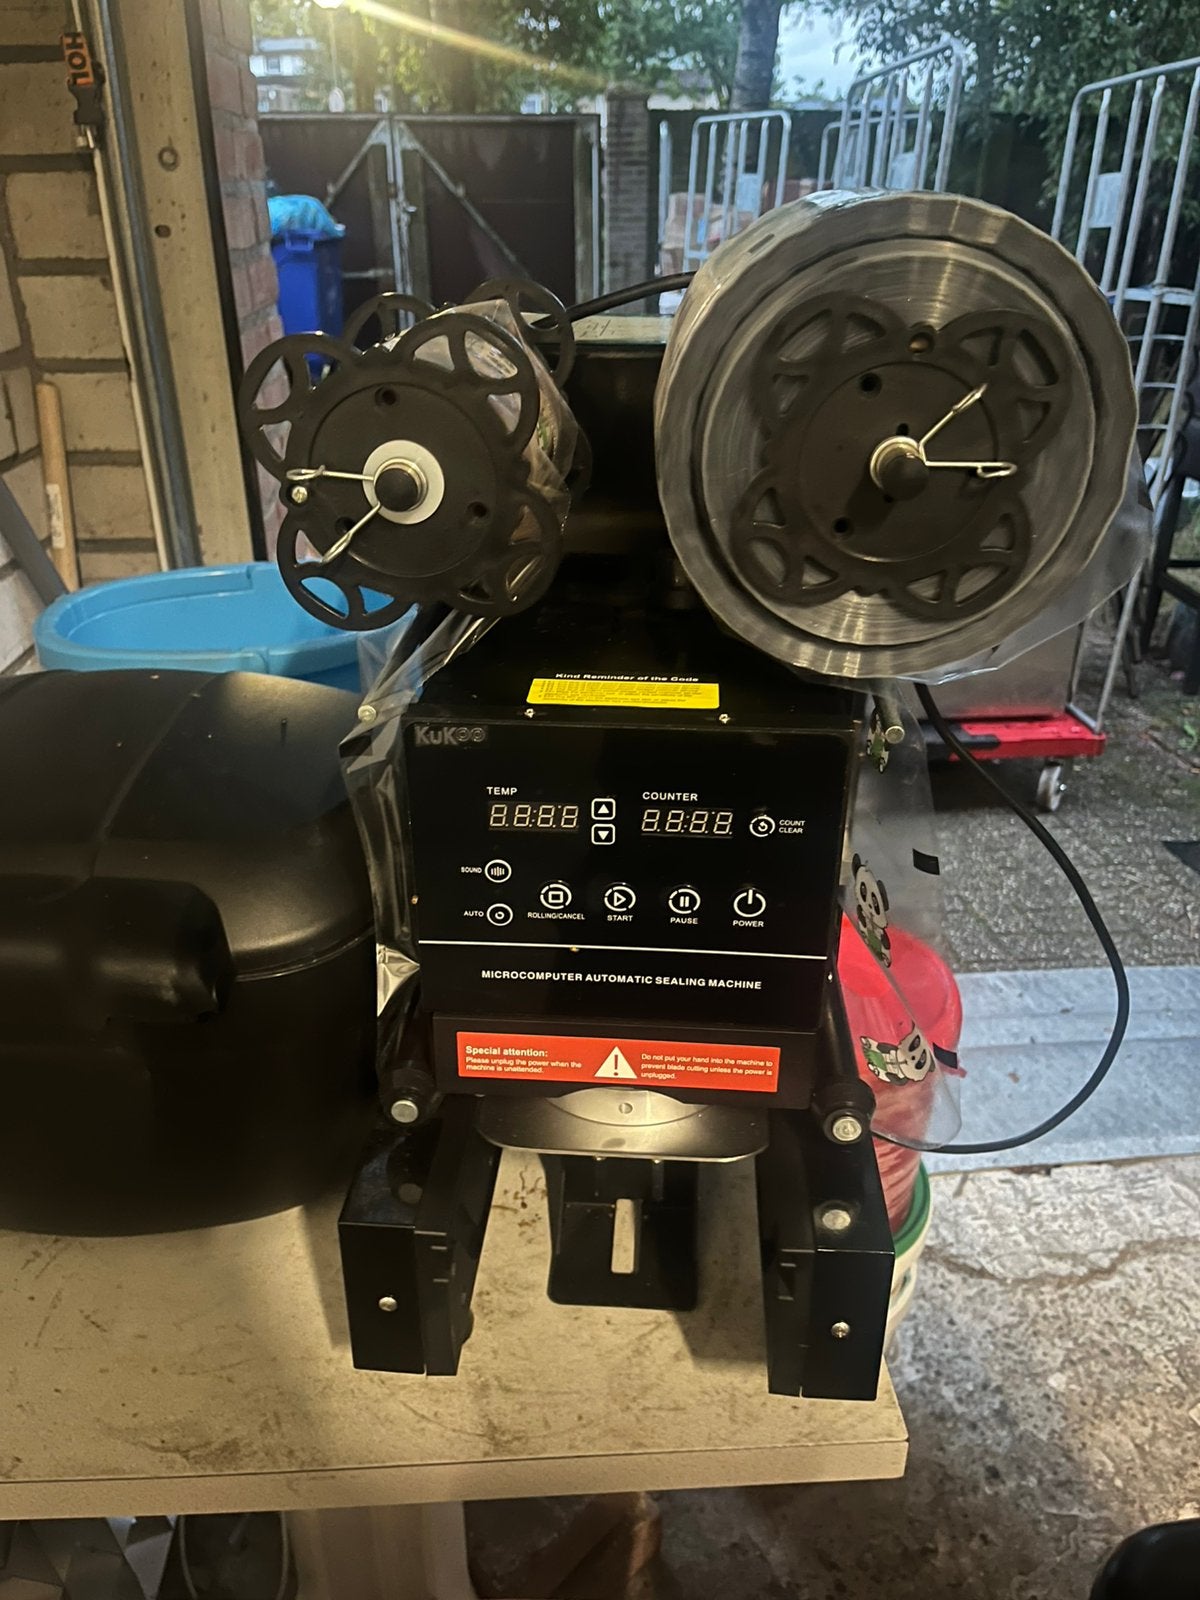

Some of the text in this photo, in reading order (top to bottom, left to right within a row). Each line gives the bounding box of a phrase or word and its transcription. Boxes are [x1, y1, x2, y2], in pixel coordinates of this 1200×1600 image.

[486, 786, 518, 796] TEMP
[642, 791, 698, 802] COUNTER
[779, 819, 806, 827] COUNT
[778, 827, 804, 835] CLEAR
[460, 866, 483, 874] SOUND
[463, 910, 484, 918] AUTO
[527, 911, 586, 921] ROLLING/CANCEL
[606, 914, 634, 923] START
[669, 916, 699, 926] PAUSE
[732, 919, 765, 928] POWER
[481, 970, 762, 990] MICROCOMPUTER AUTOMATIC SEALING MACHINE
[465, 1045, 549, 1058] Special attention:
[465, 1057, 490, 1065] Please
[491, 1059, 515, 1067] unplug
[515, 1059, 527, 1067] the
[641, 1053, 652, 1061] Do
[664, 1055, 676, 1063] put
[676, 1056, 692, 1064] your
[692, 1056, 710, 1064] hand
[711, 1057, 724, 1065] into
[724, 1057, 736, 1065] the
[737, 1058, 765, 1067] machine
[766, 1060, 774, 1068] to
[465, 1064, 496, 1072] machine
[504, 1066, 545, 1074] unattended.
[641, 1062, 667, 1071] prevent
[667, 1064, 686, 1072] blade
[687, 1065, 709, 1074] cutting
[710, 1066, 731, 1074] unless
[733, 1067, 744, 1075] the
[744, 1068, 766, 1076] power
[641, 1071, 677, 1080] unplugged.
